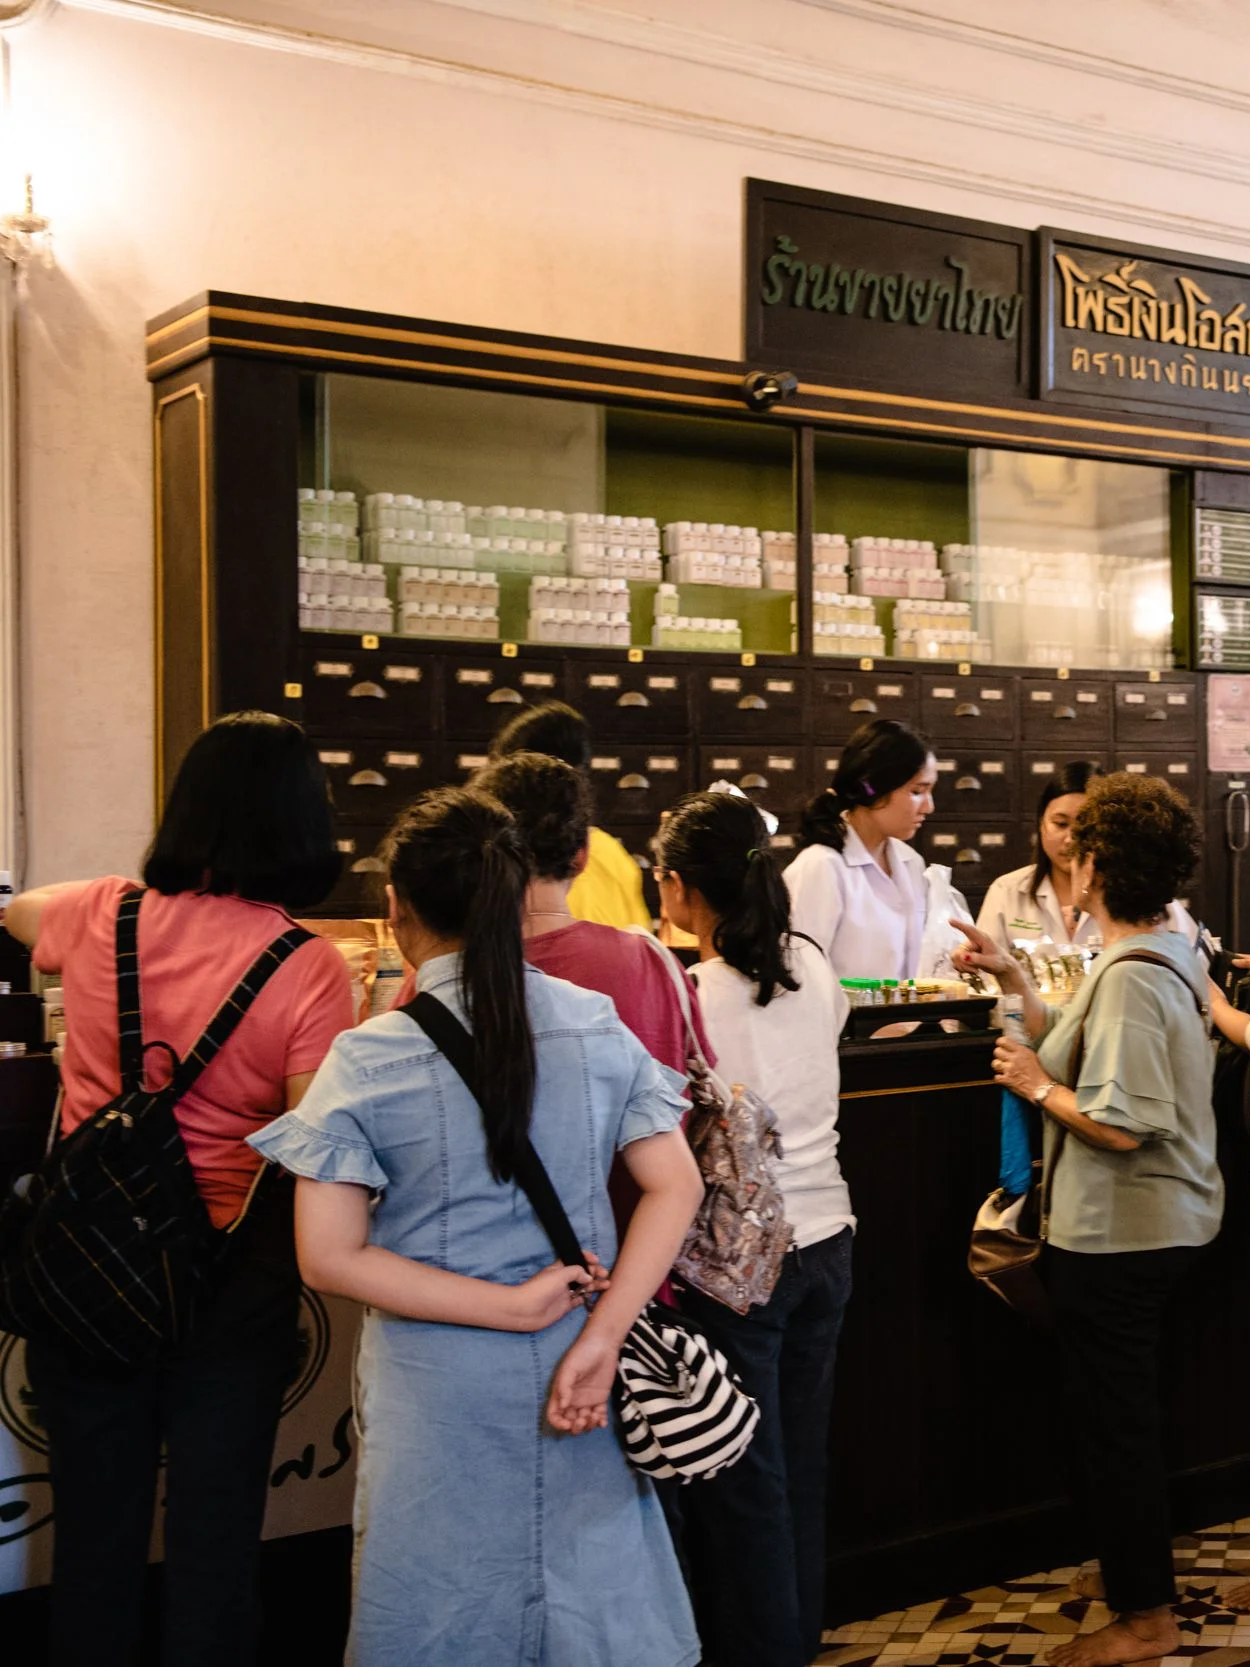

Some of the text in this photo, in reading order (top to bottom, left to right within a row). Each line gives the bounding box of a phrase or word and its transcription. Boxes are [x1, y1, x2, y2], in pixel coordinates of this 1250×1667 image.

[762, 234, 1023, 340] ร้านขายยาไทย
